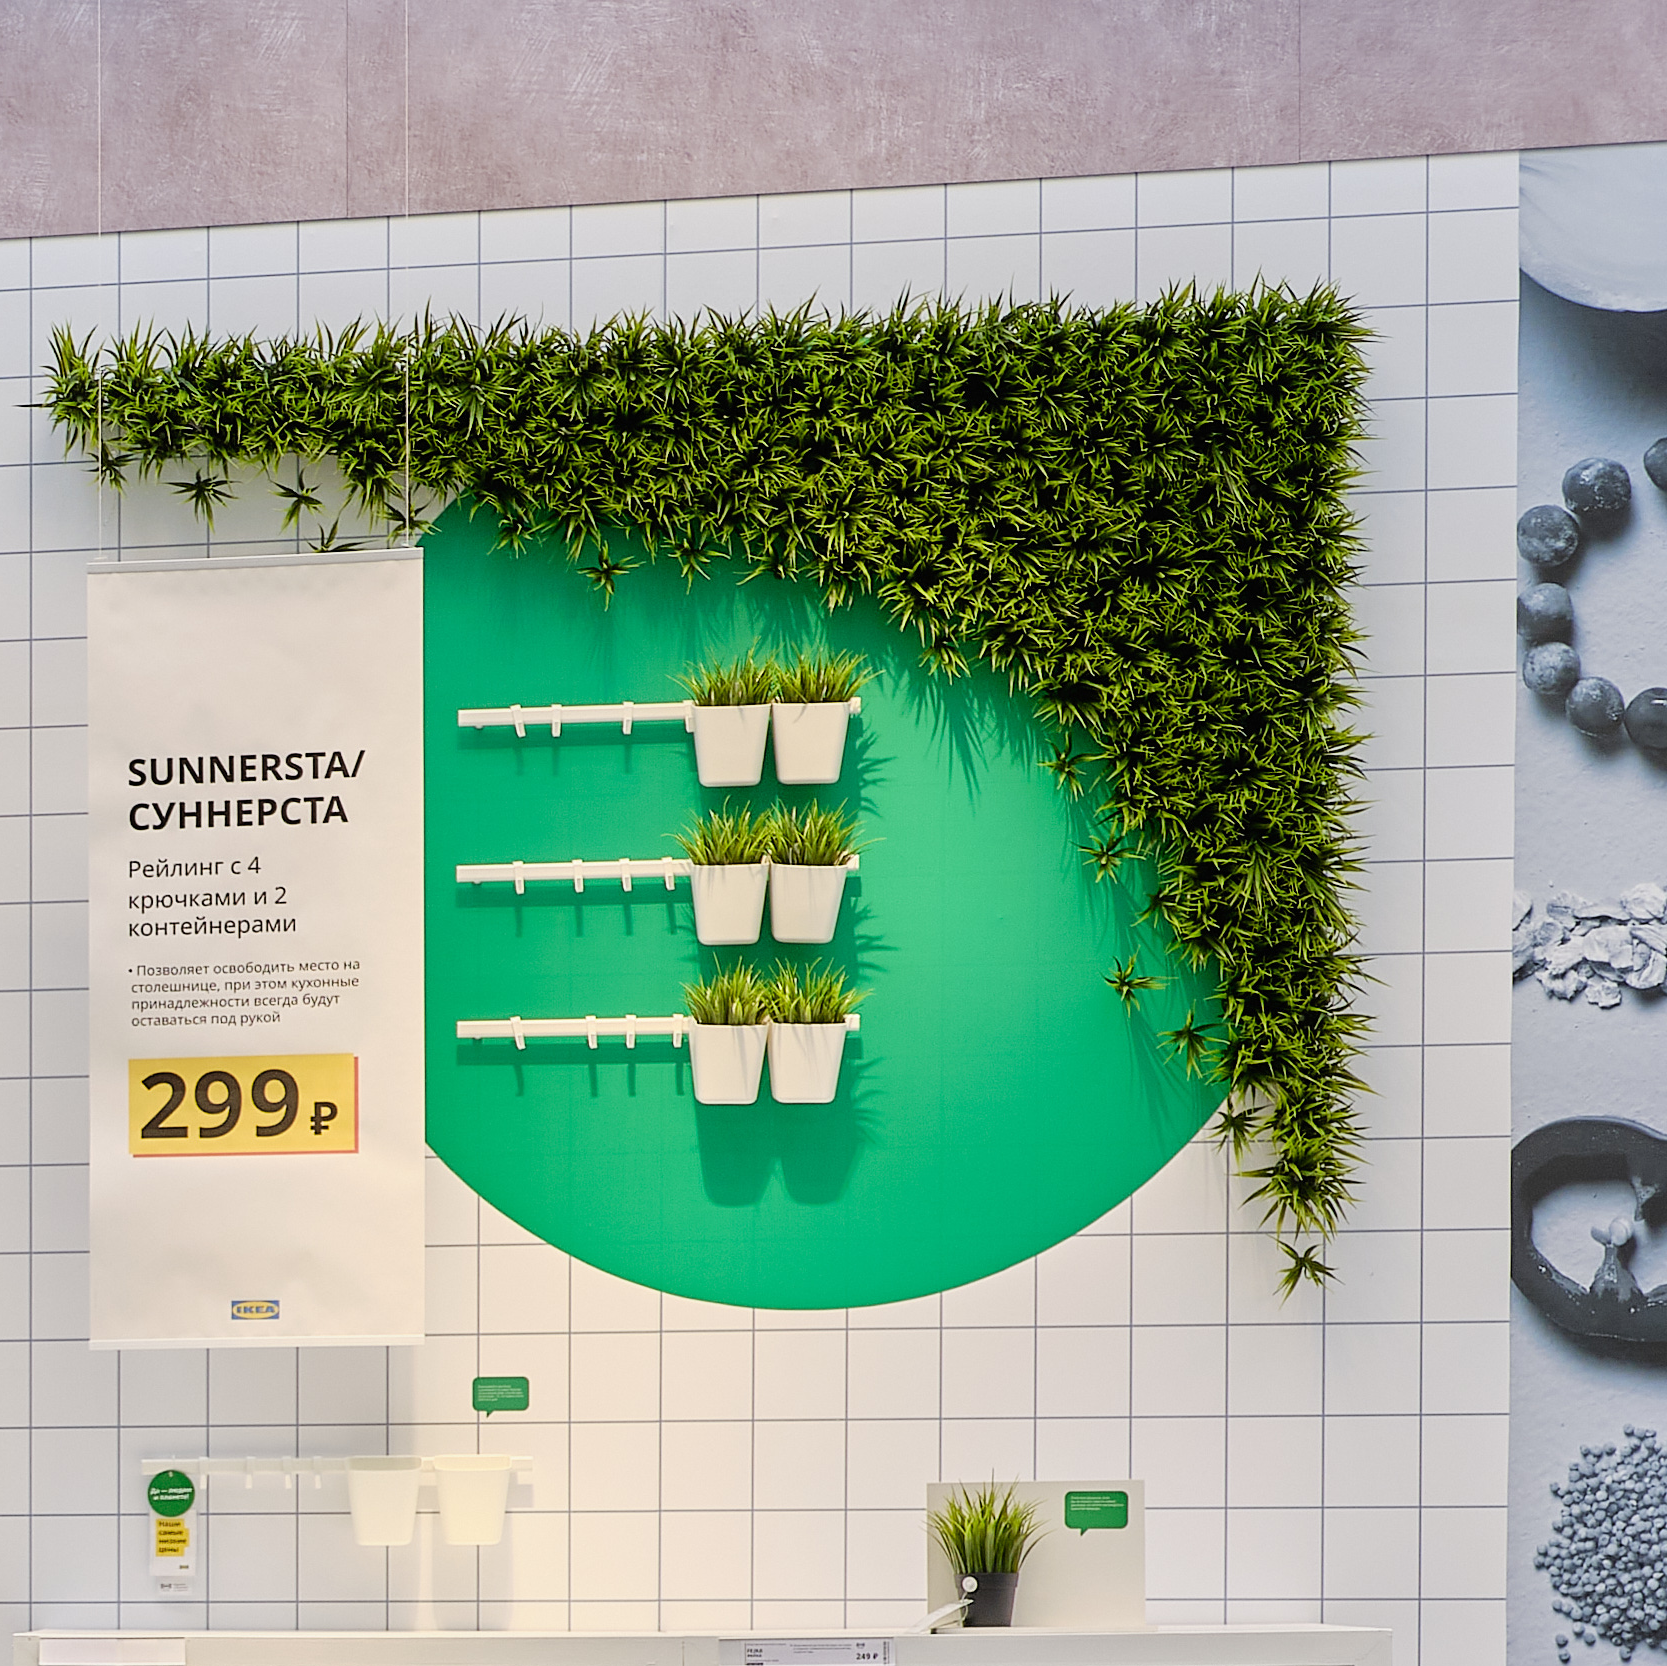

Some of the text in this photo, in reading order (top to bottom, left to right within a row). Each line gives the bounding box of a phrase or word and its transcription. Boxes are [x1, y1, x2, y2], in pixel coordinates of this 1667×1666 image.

[129, 750, 365, 786] SUNNERSTA/
[130, 796, 348, 830] СУННЕРСТА
[130, 857, 261, 878] Рейлинг с 4
[129, 887, 286, 914] крючками и 2
[129, 917, 295, 939] контейнерами
[137, 965, 209, 976] Позволяет
[213, 962, 294, 974] освободить
[132, 983, 220, 993] столешнице,
[225, 981, 250, 993] при
[292, 978, 358, 991] кухонные
[132, 993, 339, 1012] принадлежности всегда будут
[132, 1011, 280, 1026] оставаться под рукой
[236, 1304, 275, 1315] IKEA
